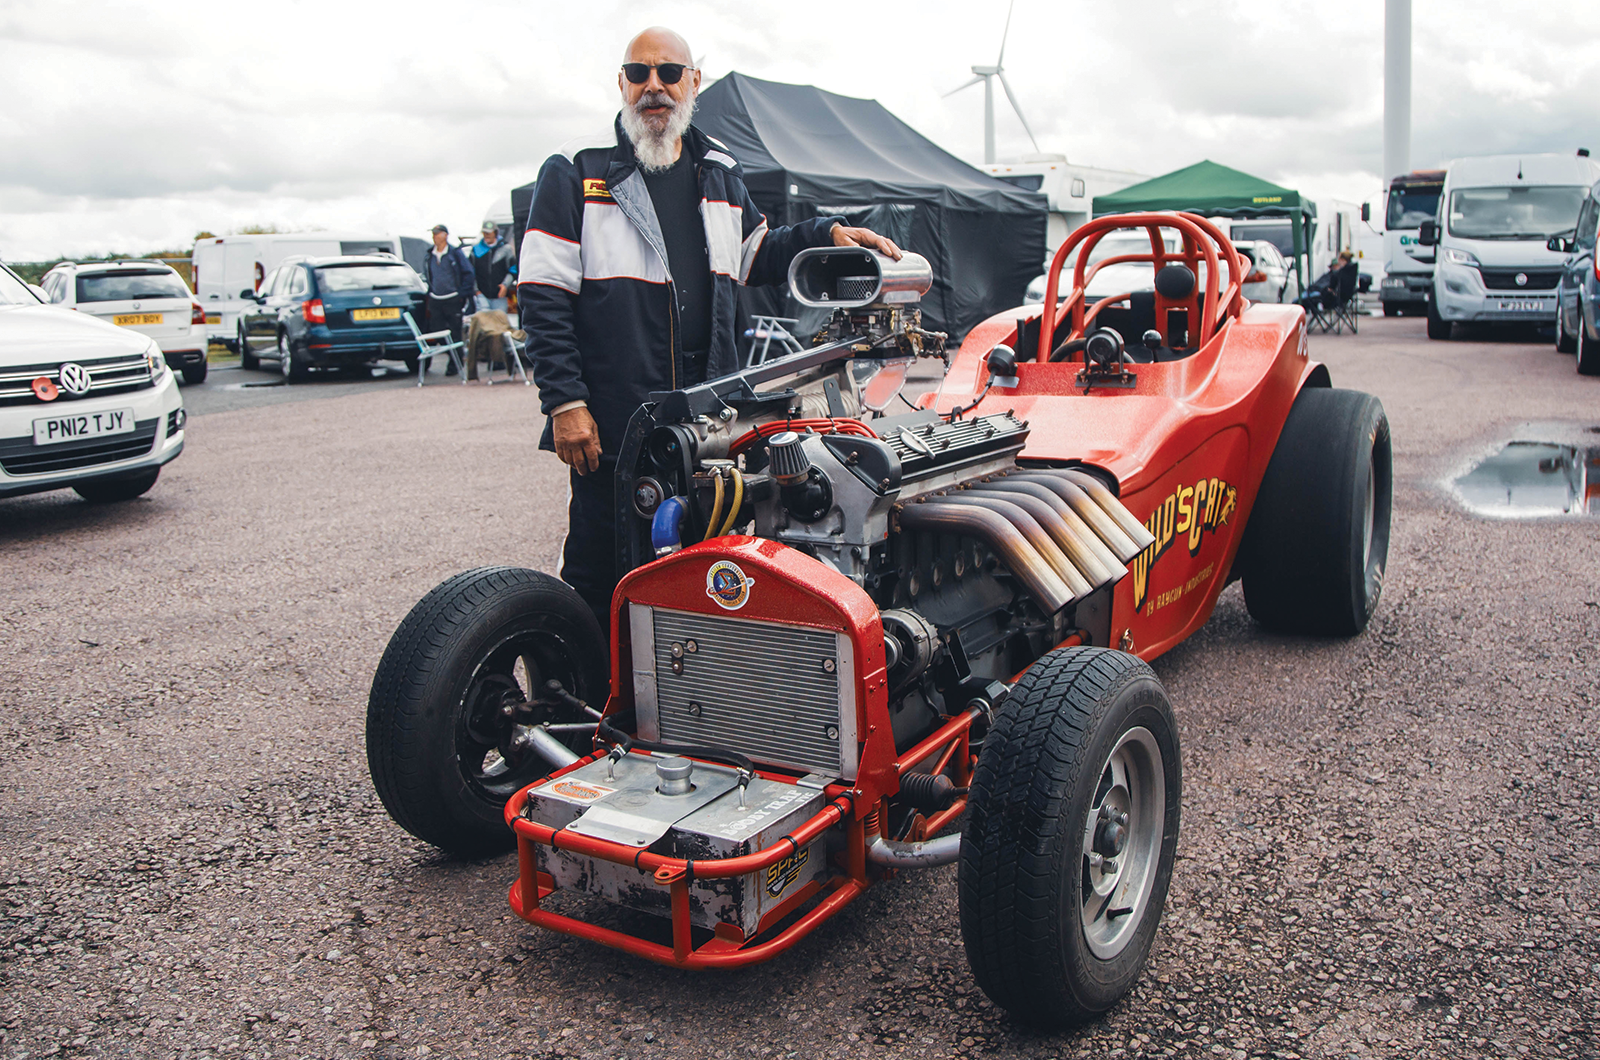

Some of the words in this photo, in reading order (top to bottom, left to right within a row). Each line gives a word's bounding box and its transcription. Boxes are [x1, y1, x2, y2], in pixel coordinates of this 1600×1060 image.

[47, 416, 89, 439] PN12
[93, 411, 124, 432] TJY
[1146, 599, 1155, 617] BY
[719, 809, 772, 836] BOOBY
[764, 789, 802, 810] TRAP
